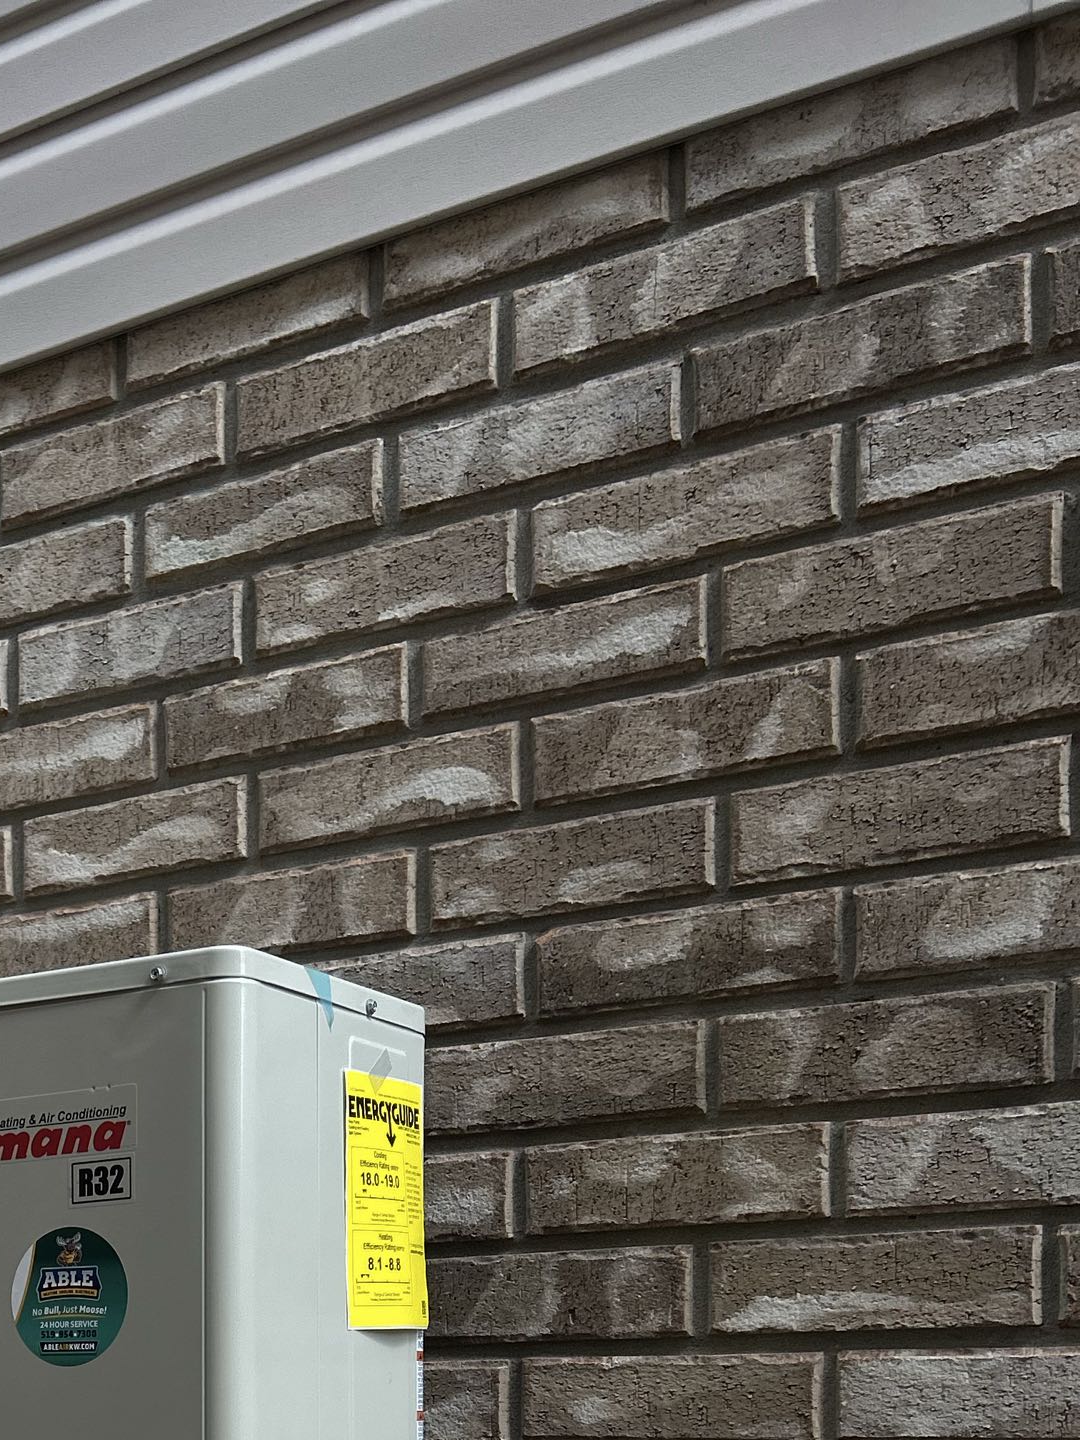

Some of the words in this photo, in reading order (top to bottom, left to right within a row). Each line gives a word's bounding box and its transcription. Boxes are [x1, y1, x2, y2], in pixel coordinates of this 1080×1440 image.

[29, 1114, 37, 1125] &
[38, 1111, 56, 1125] Air
[57, 1105, 127, 1123] Conditioning
[348, 1095, 420, 1130] ENERGYGUIDE
[78, 1164, 125, 1197] R32
[42, 1270, 94, 1289] ABLE
[32, 1308, 43, 1316] No
[44, 1306, 61, 1316] Bull,
[62, 1305, 78, 1314] Just
[79, 1305, 108, 1315] Moose!
